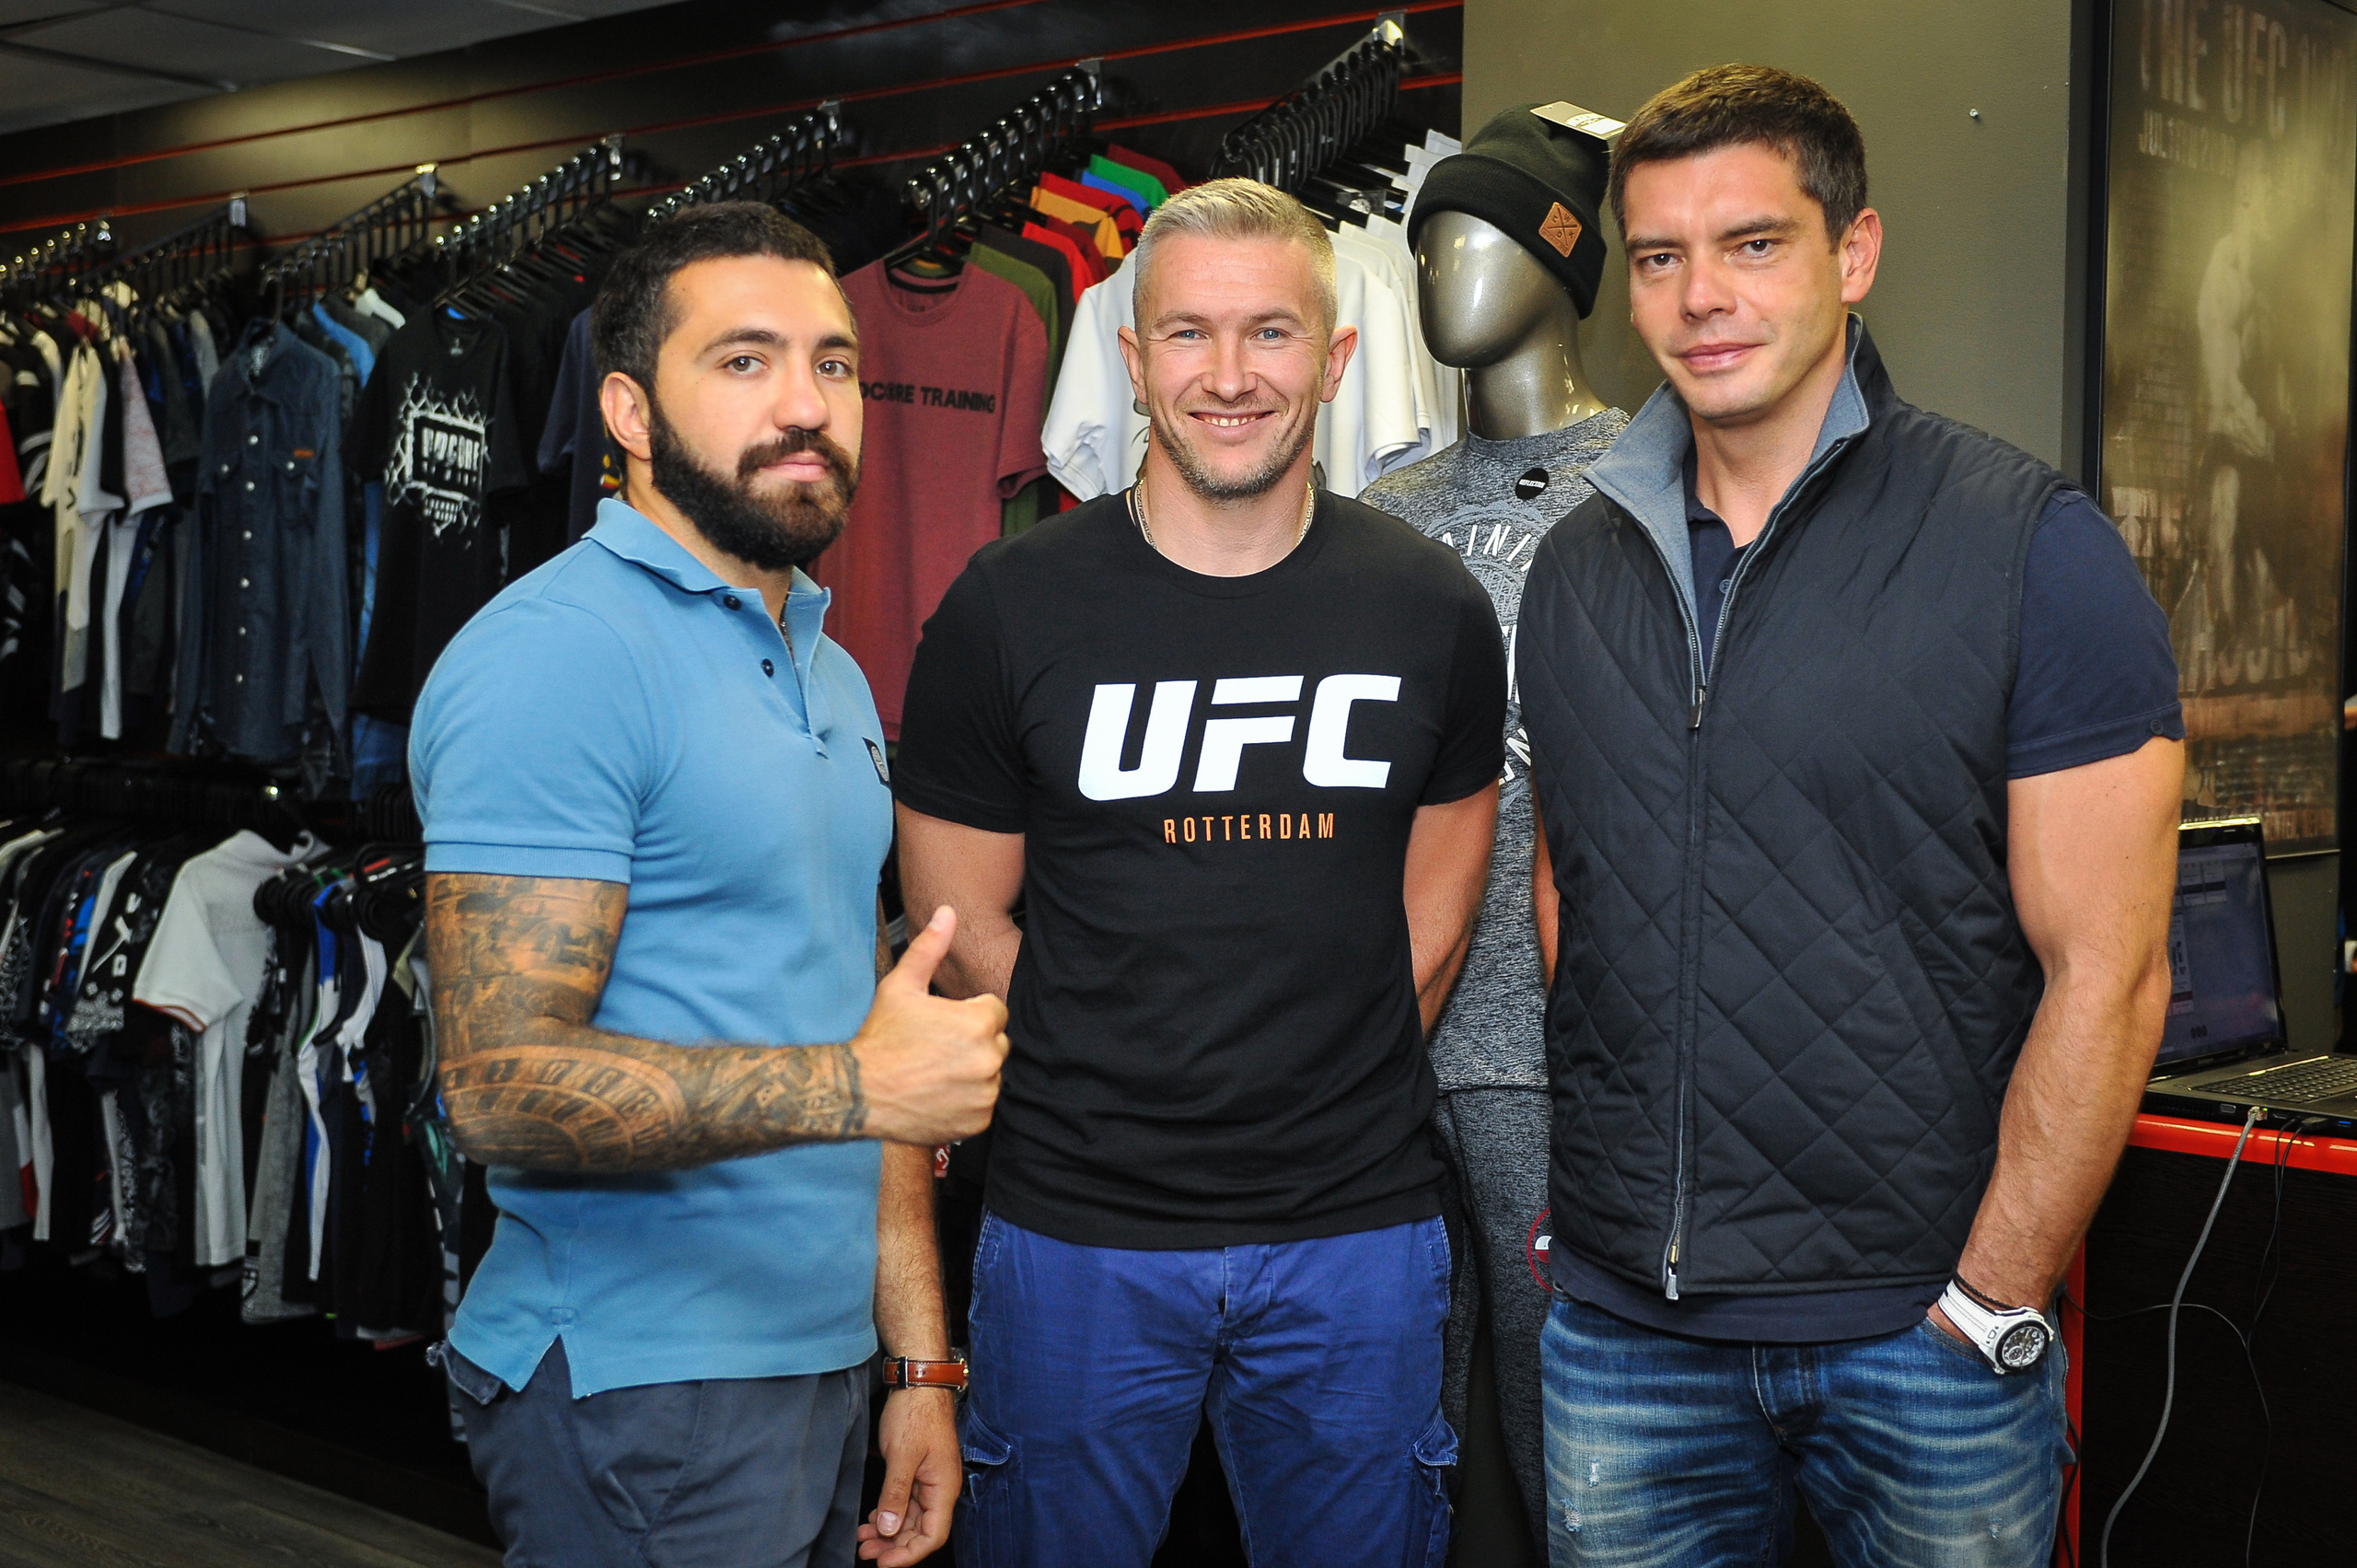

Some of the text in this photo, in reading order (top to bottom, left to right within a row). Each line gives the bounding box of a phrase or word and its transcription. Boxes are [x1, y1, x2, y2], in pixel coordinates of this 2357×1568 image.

[921, 386, 995, 413] TRAINING
[1078, 673, 1402, 801] UFC
[1163, 812, 1335, 843] ROTTERDAM
